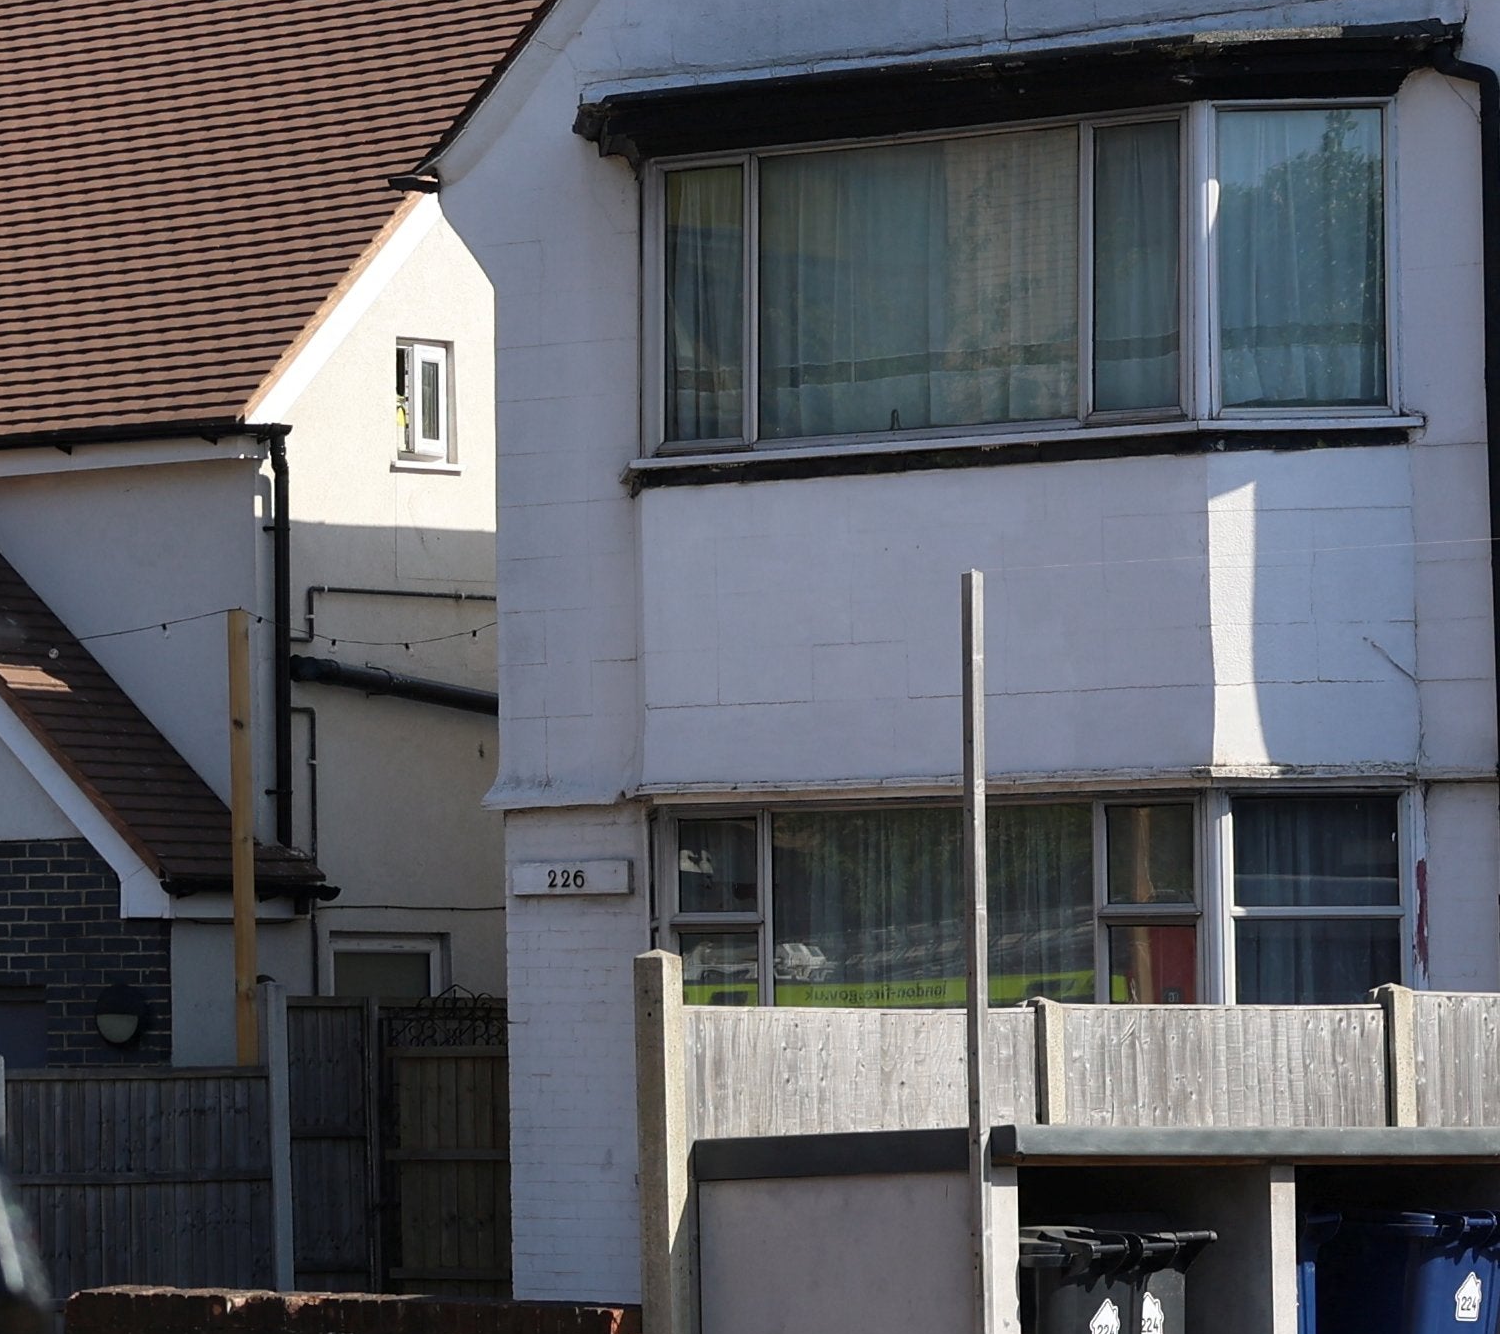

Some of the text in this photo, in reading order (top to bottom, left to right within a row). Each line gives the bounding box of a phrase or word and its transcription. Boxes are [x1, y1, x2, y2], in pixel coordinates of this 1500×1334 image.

[548, 870, 585, 888] 226
[1460, 1295, 1477, 1312] 224
[1141, 1318, 1159, 1334] 224
